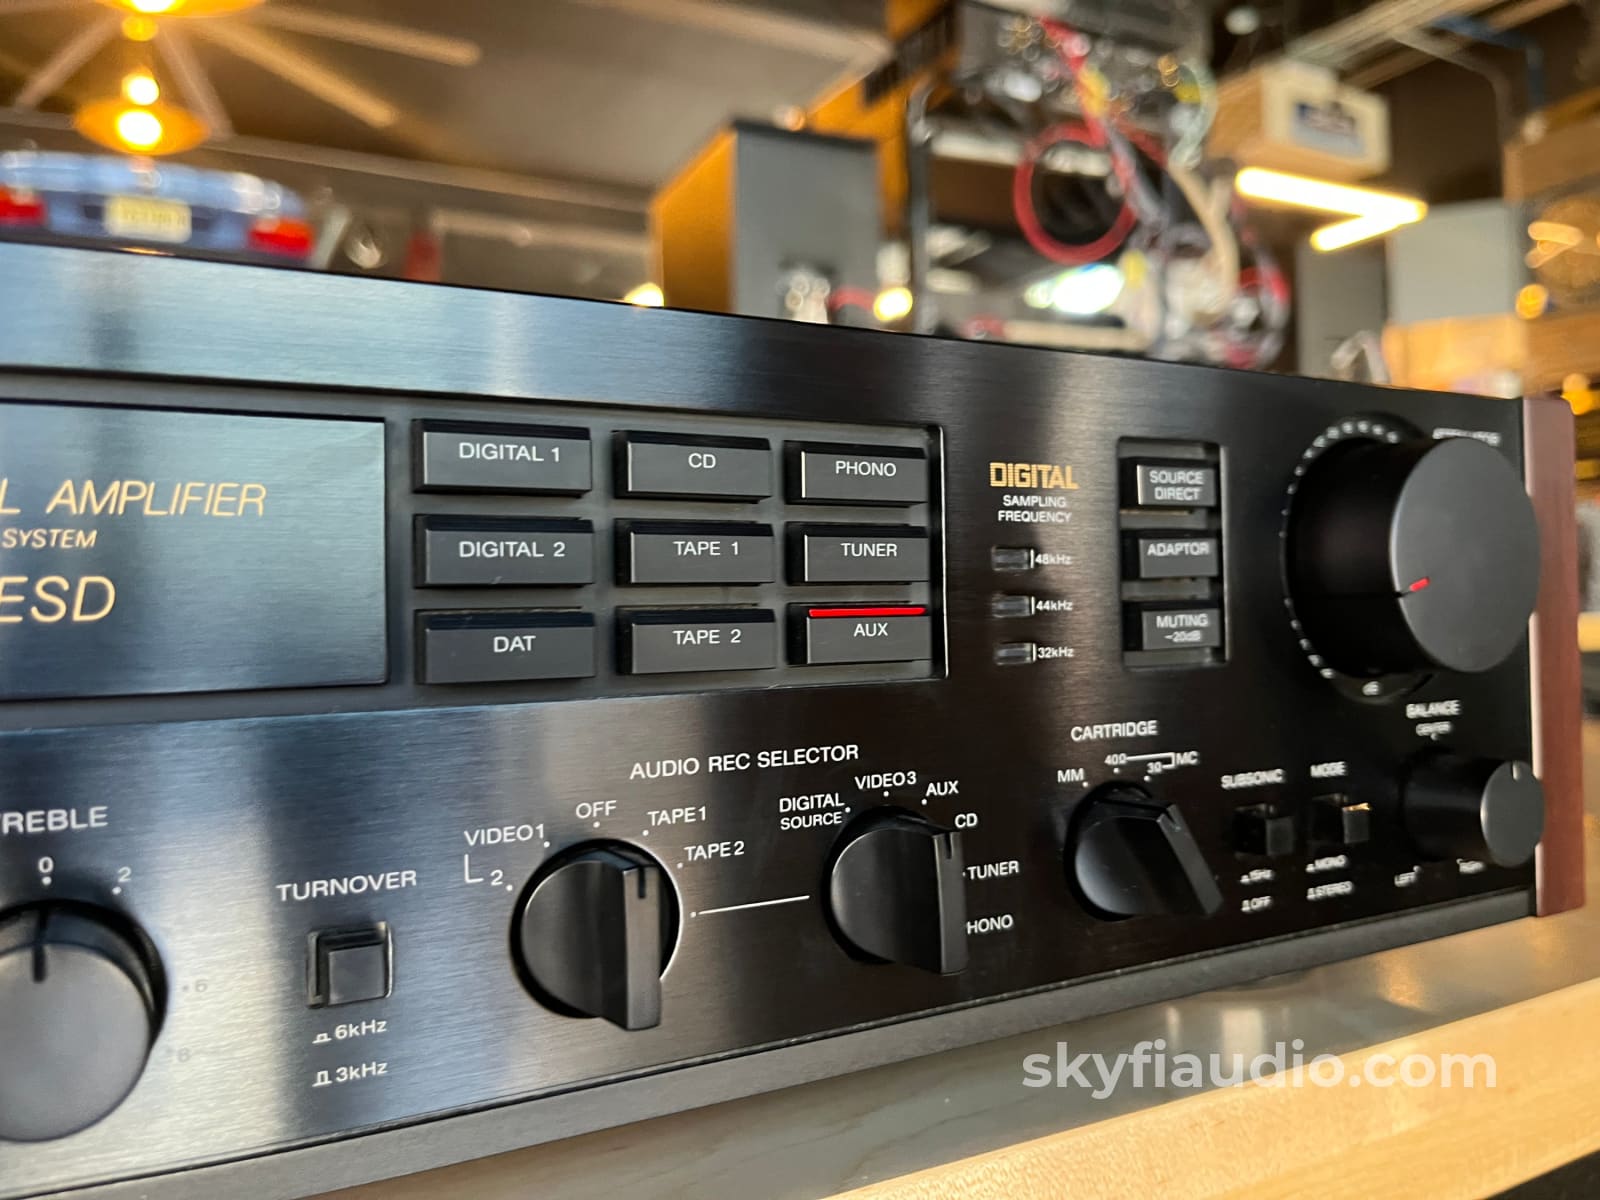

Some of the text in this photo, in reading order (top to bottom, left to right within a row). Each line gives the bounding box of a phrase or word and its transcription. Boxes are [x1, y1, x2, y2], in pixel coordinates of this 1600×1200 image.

[458, 442, 561, 463] DIGITAL 1
[687, 453, 717, 469] CD
[835, 460, 897, 478] PHONO
[989, 462, 1080, 489] DIGITAL
[1149, 470, 1204, 485] SOURCE
[46, 479, 267, 517] AMPLIFIER
[1003, 494, 1067, 508] SAMPLING
[1154, 487, 1202, 501] DIRECT
[998, 510, 1072, 524] FREQUENCY
[2, 528, 98, 549] SYSTEM
[458, 541, 566, 558] DIGITAL 2
[673, 541, 739, 556] TAPE 1
[841, 542, 898, 557] TUNER
[1147, 541, 1210, 556] ADAPTOR
[1035, 553, 1073, 565] 48kHz
[0, 575, 116, 622] ESD
[1036, 600, 1073, 612] 44kHz
[1156, 613, 1209, 629] MUTING
[673, 629, 742, 645] TAPE 2
[853, 623, 889, 637] AUX
[493, 635, 537, 653] DAT
[1037, 646, 1075, 659] 32kHz
[1406, 700, 1461, 719] BALANCE
[1070, 719, 1159, 742] CARTRIDGE
[630, 744, 859, 780] AUDIO REC SELECTOR
[1175, 750, 1199, 766] MC
[1057, 768, 1085, 783] MM
[1310, 760, 1348, 778] MODE
[1220, 768, 1286, 790] SUBSONIC
[925, 780, 959, 797] AUX
[575, 801, 617, 819] OFF
[779, 793, 845, 813] DIGITAL
[0, 806, 109, 834] REBLE
[780, 812, 843, 830] SOURCE
[954, 812, 979, 829] CD
[38, 856, 54, 873] 0
[968, 860, 1020, 880] TUNER
[117, 866, 132, 882] 2
[489, 869, 504, 885] 2
[276, 870, 418, 901] TURNOVER
[1251, 895, 1273, 910] OFF
[966, 914, 1014, 935] HONO
[335, 1019, 388, 1040] 6kHz
[335, 1061, 389, 1082] 3kHz
